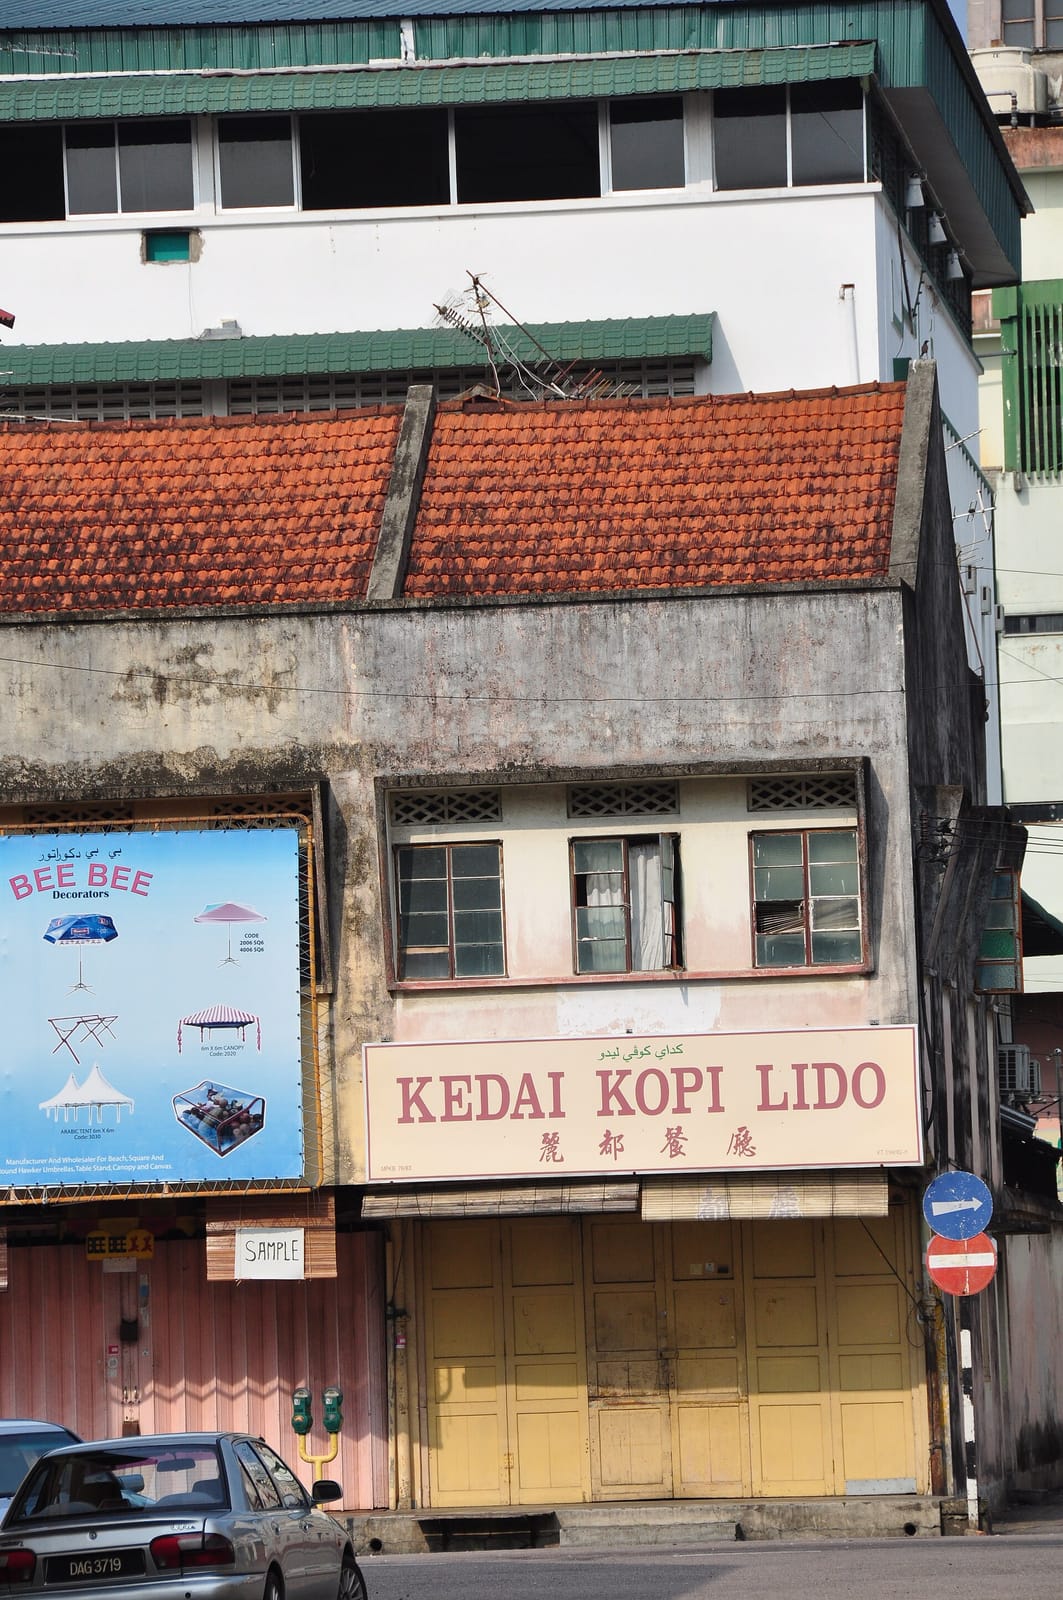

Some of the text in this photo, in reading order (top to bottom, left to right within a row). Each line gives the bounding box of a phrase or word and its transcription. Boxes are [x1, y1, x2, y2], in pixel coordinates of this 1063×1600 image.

[8, 863, 154, 901] BEE BEE
[52, 889, 110, 900] Decorators
[396, 1061, 887, 1124] KEDAI KOPI LIDO
[539, 1126, 758, 1163] 麗都餐廳
[18, 1166, 42, 1174] Hawker
[75, 1164, 92, 1172] Table
[112, 1163, 136, 1173] Canopy
[136, 1162, 149, 1170] and
[61, 1156, 97, 1164] Wholesaler
[97, 1155, 107, 1163] For
[245, 1239, 300, 1262] SAMPLE
[70, 1557, 122, 1576] DAG 3719
